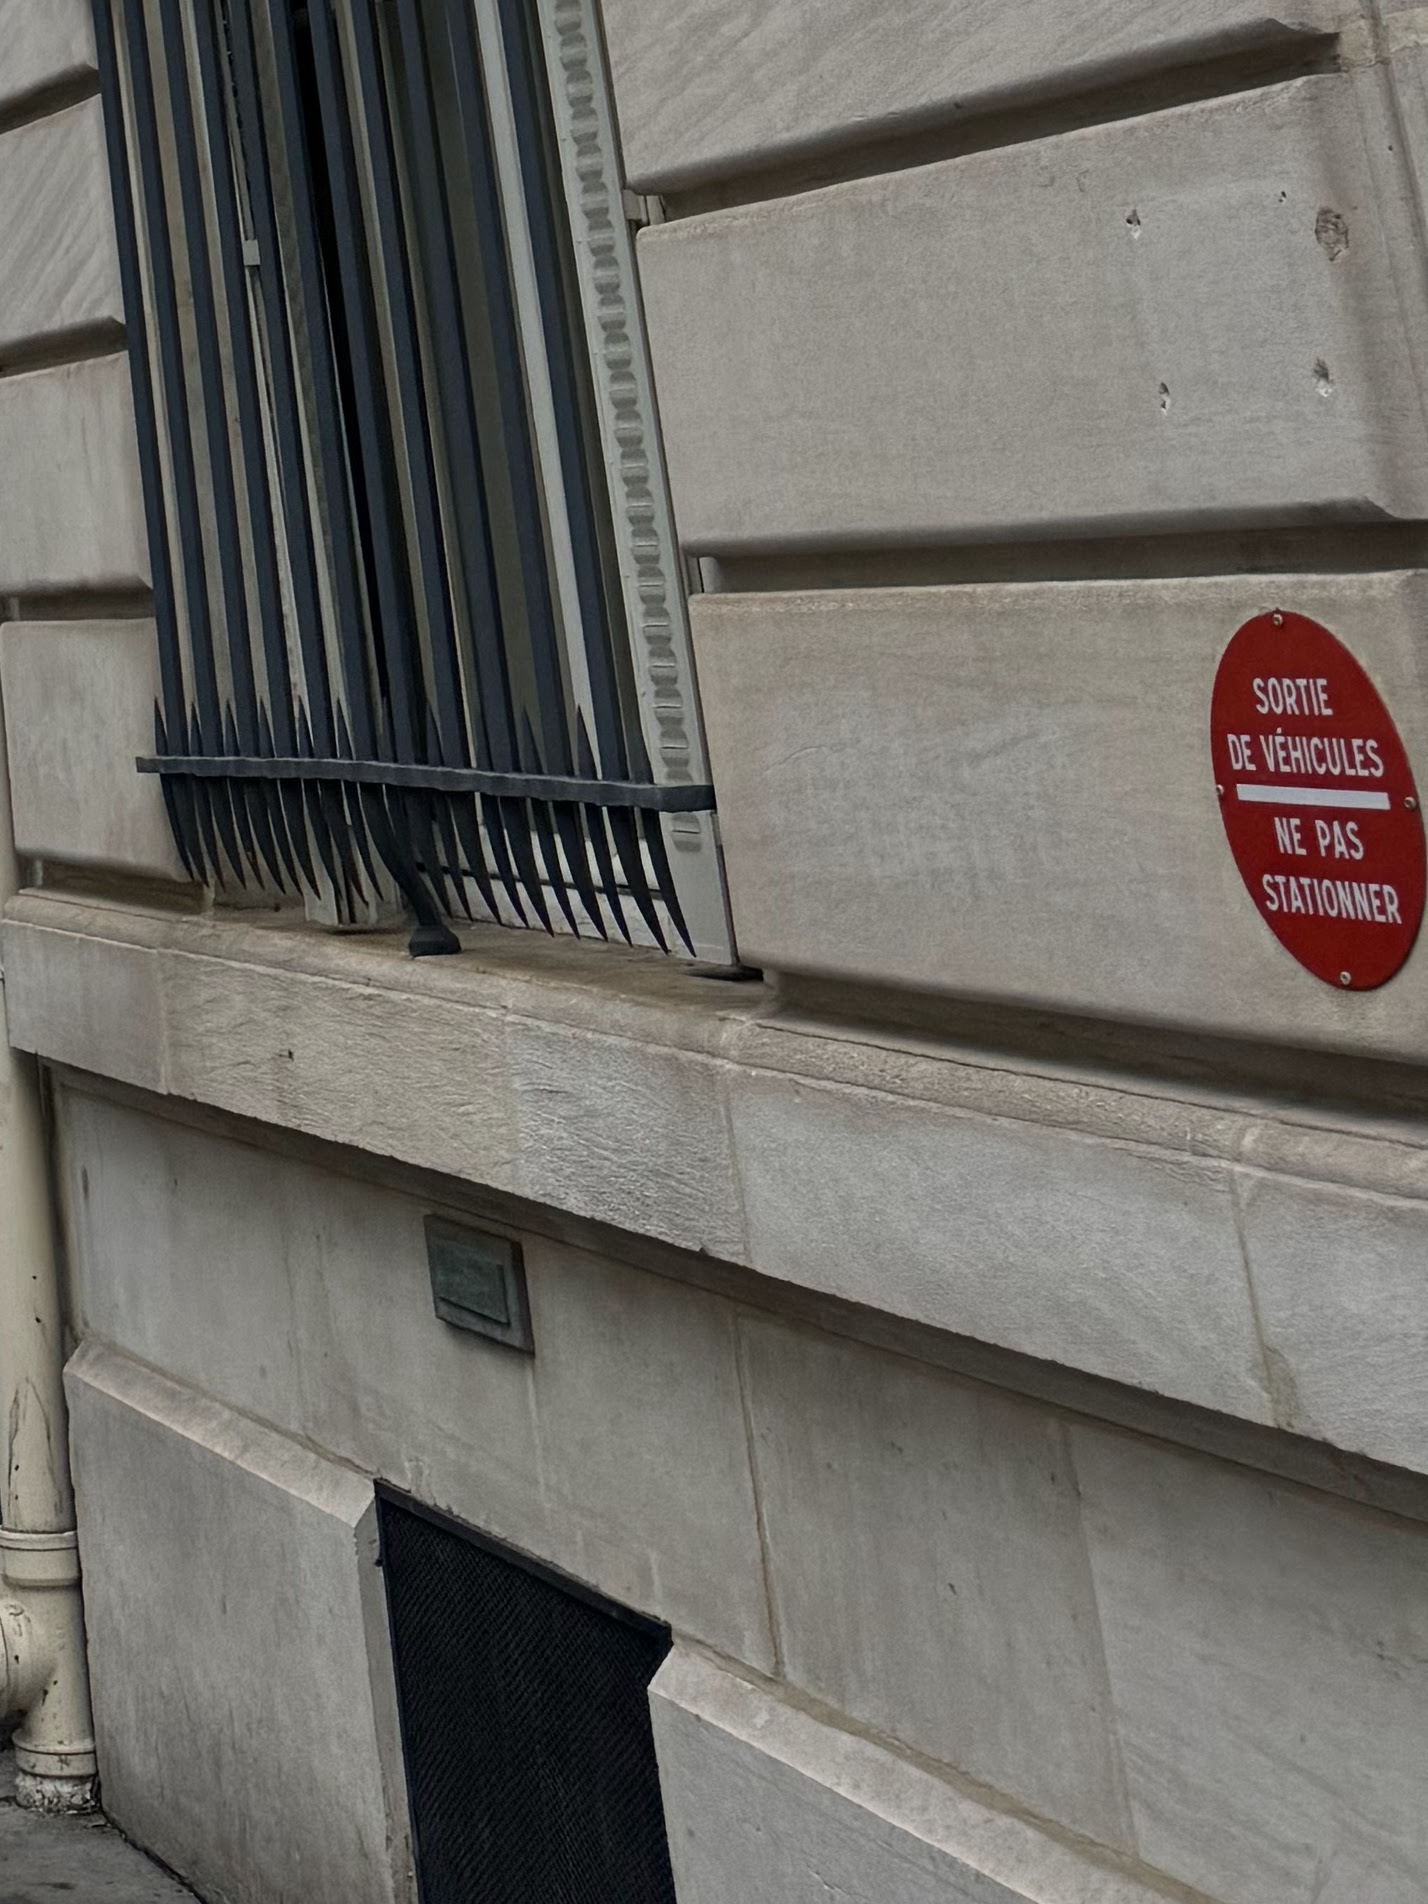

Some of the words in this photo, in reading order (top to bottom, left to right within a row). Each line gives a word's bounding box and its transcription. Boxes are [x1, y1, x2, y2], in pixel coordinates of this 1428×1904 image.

[1252, 676, 1334, 716] SORTIE
[1227, 733, 1257, 772] DE
[1259, 726, 1385, 778] VÉHICULES
[1274, 816, 1307, 856] NE
[1314, 819, 1364, 861] PAS
[1262, 874, 1403, 925] STATIONNER
